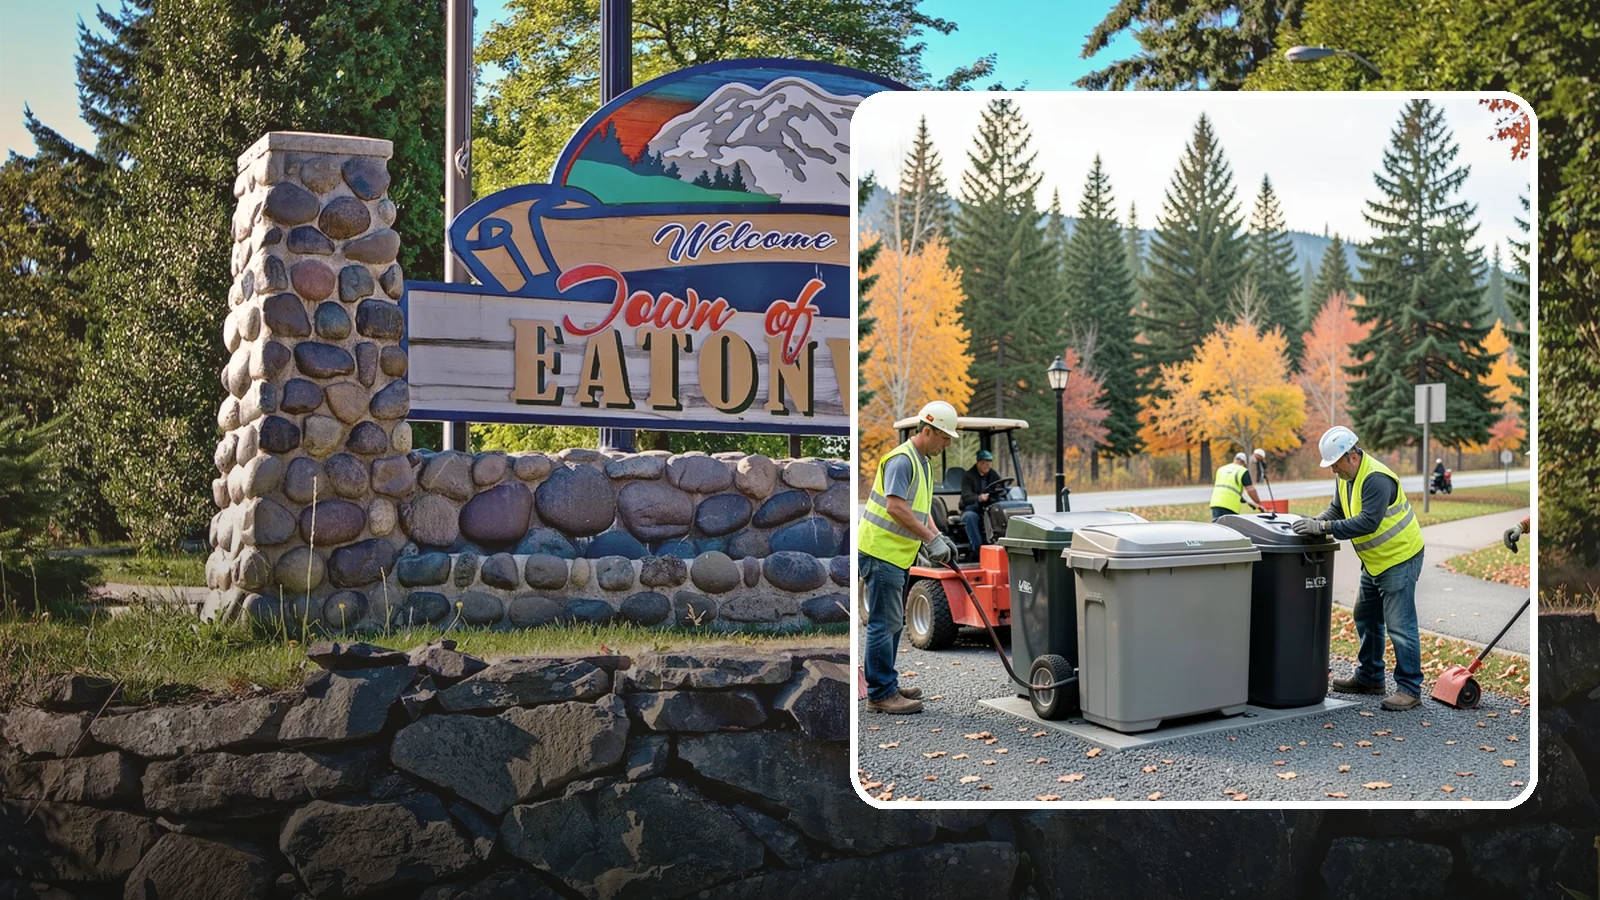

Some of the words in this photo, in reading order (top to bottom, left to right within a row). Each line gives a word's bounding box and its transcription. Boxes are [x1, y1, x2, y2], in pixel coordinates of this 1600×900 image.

[654, 221, 837, 263] Welcome
[557, 264, 736, 335] Town
[765, 279, 825, 364] of
